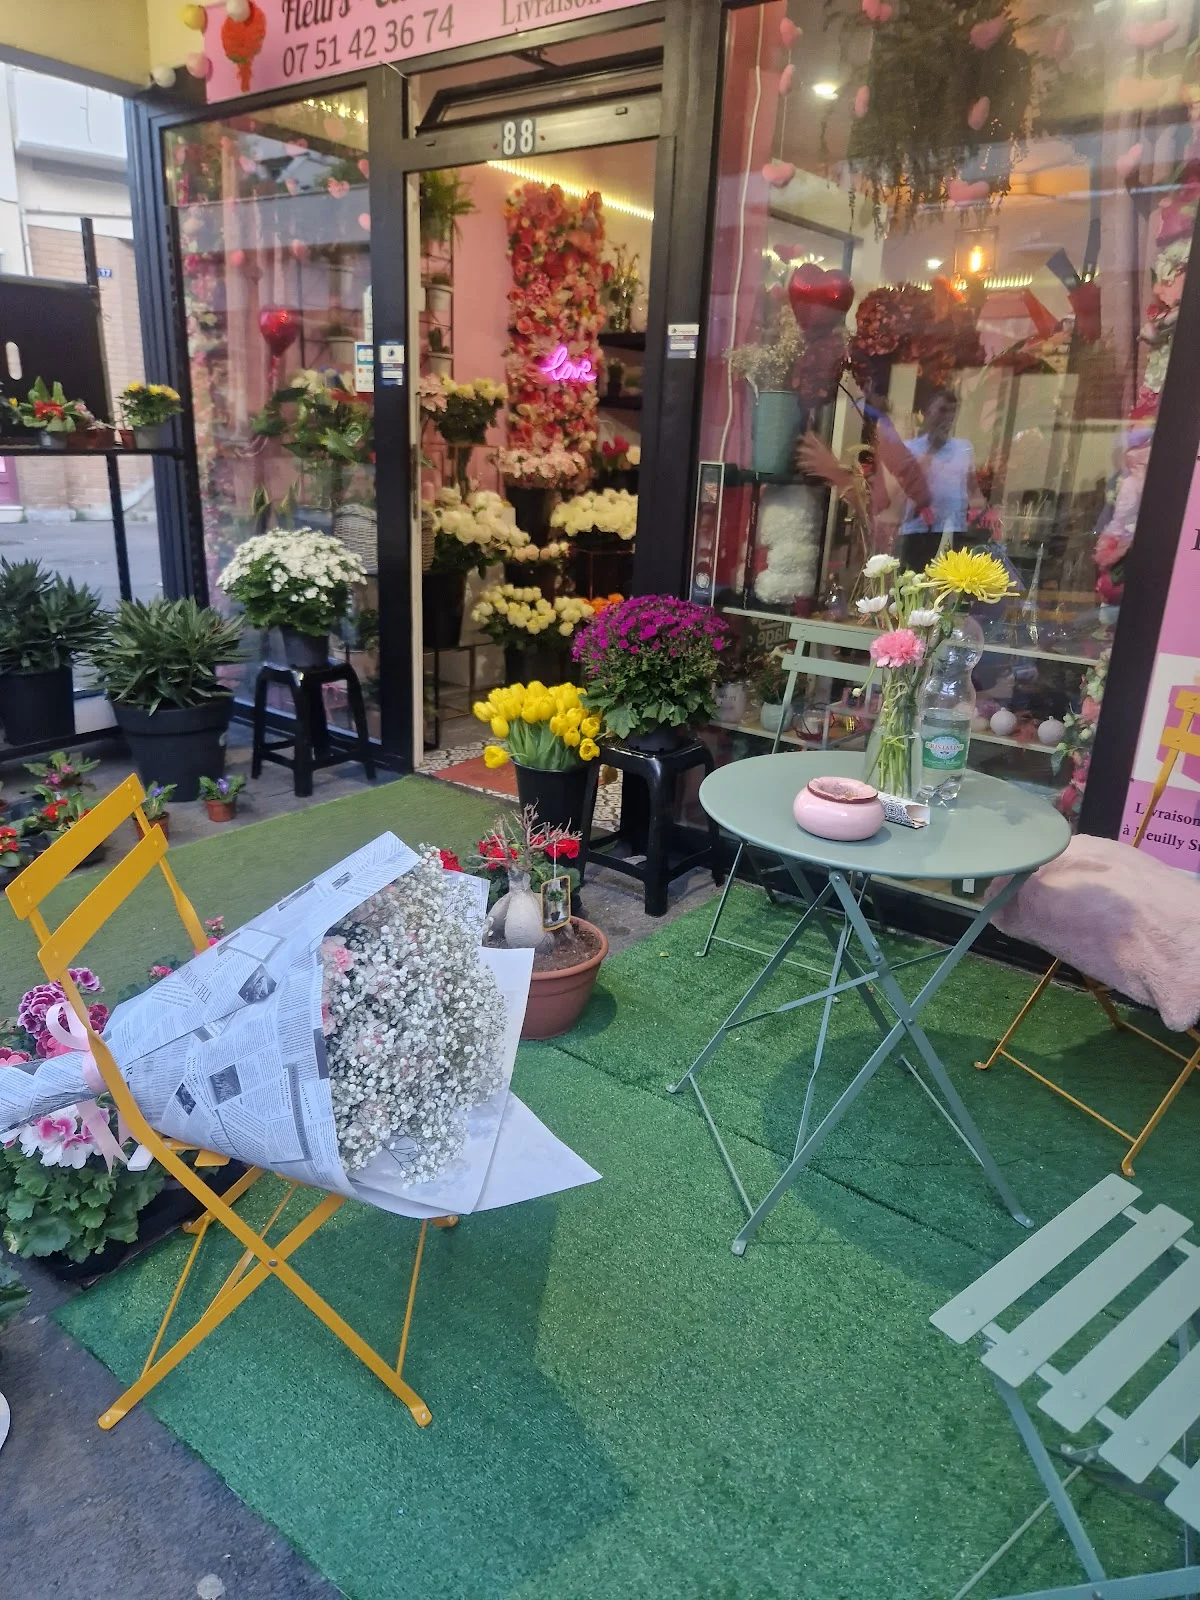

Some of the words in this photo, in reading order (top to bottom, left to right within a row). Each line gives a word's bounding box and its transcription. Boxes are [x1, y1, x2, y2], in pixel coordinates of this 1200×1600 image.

[283, 43, 309, 77] 07
[315, 35, 341, 70] 51
[348, 25, 377, 60] 42
[384, 15, 414, 53] 36
[423, 4, 455, 44] 74
[503, 119, 534, 155] 88
[540, 346, 598, 381] love
[1122, 824, 1130, 835] à
[1134, 802, 1200, 827] Lvraison
